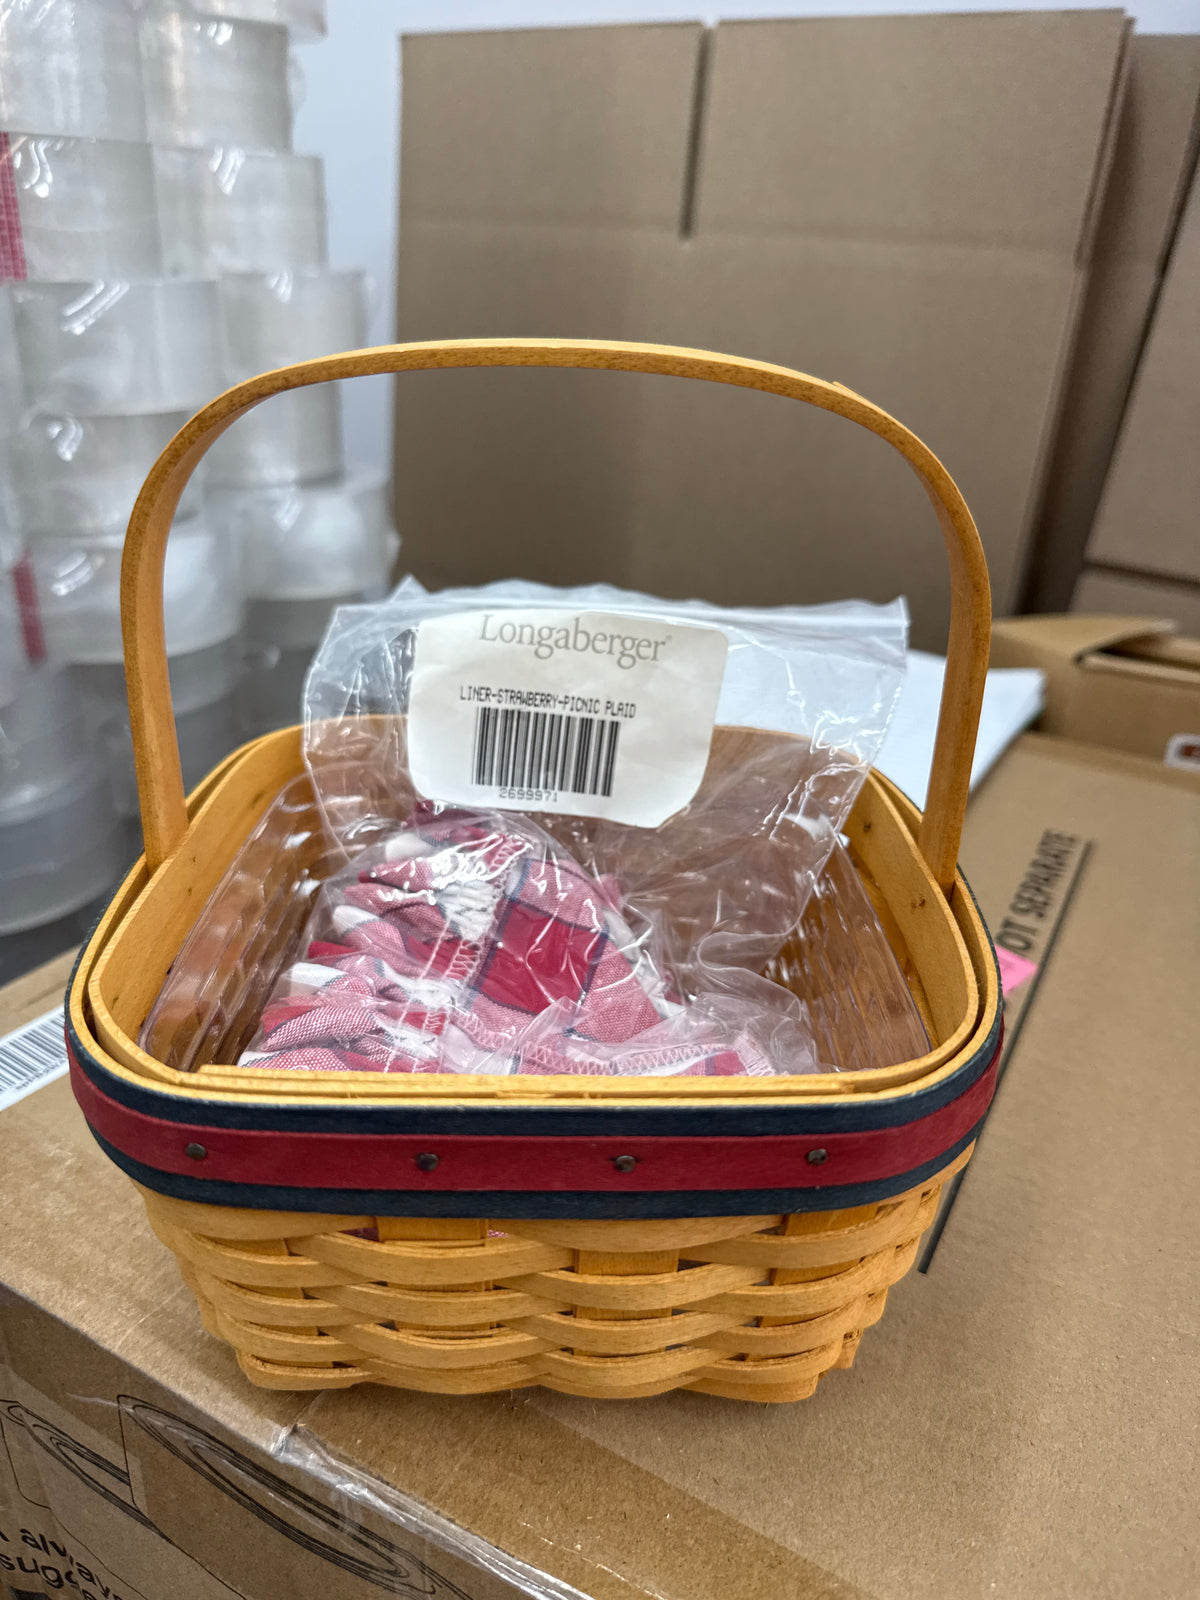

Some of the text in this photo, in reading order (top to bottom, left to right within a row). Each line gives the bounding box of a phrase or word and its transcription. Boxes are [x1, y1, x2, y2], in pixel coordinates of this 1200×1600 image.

[479, 614, 667, 670] Longaberger
[460, 685, 637, 719] LINER-STRAWBERRY-PICNIC PLAID
[499, 787, 558, 803] 2699971
[995, 828, 1077, 956] OT SEPARATE
